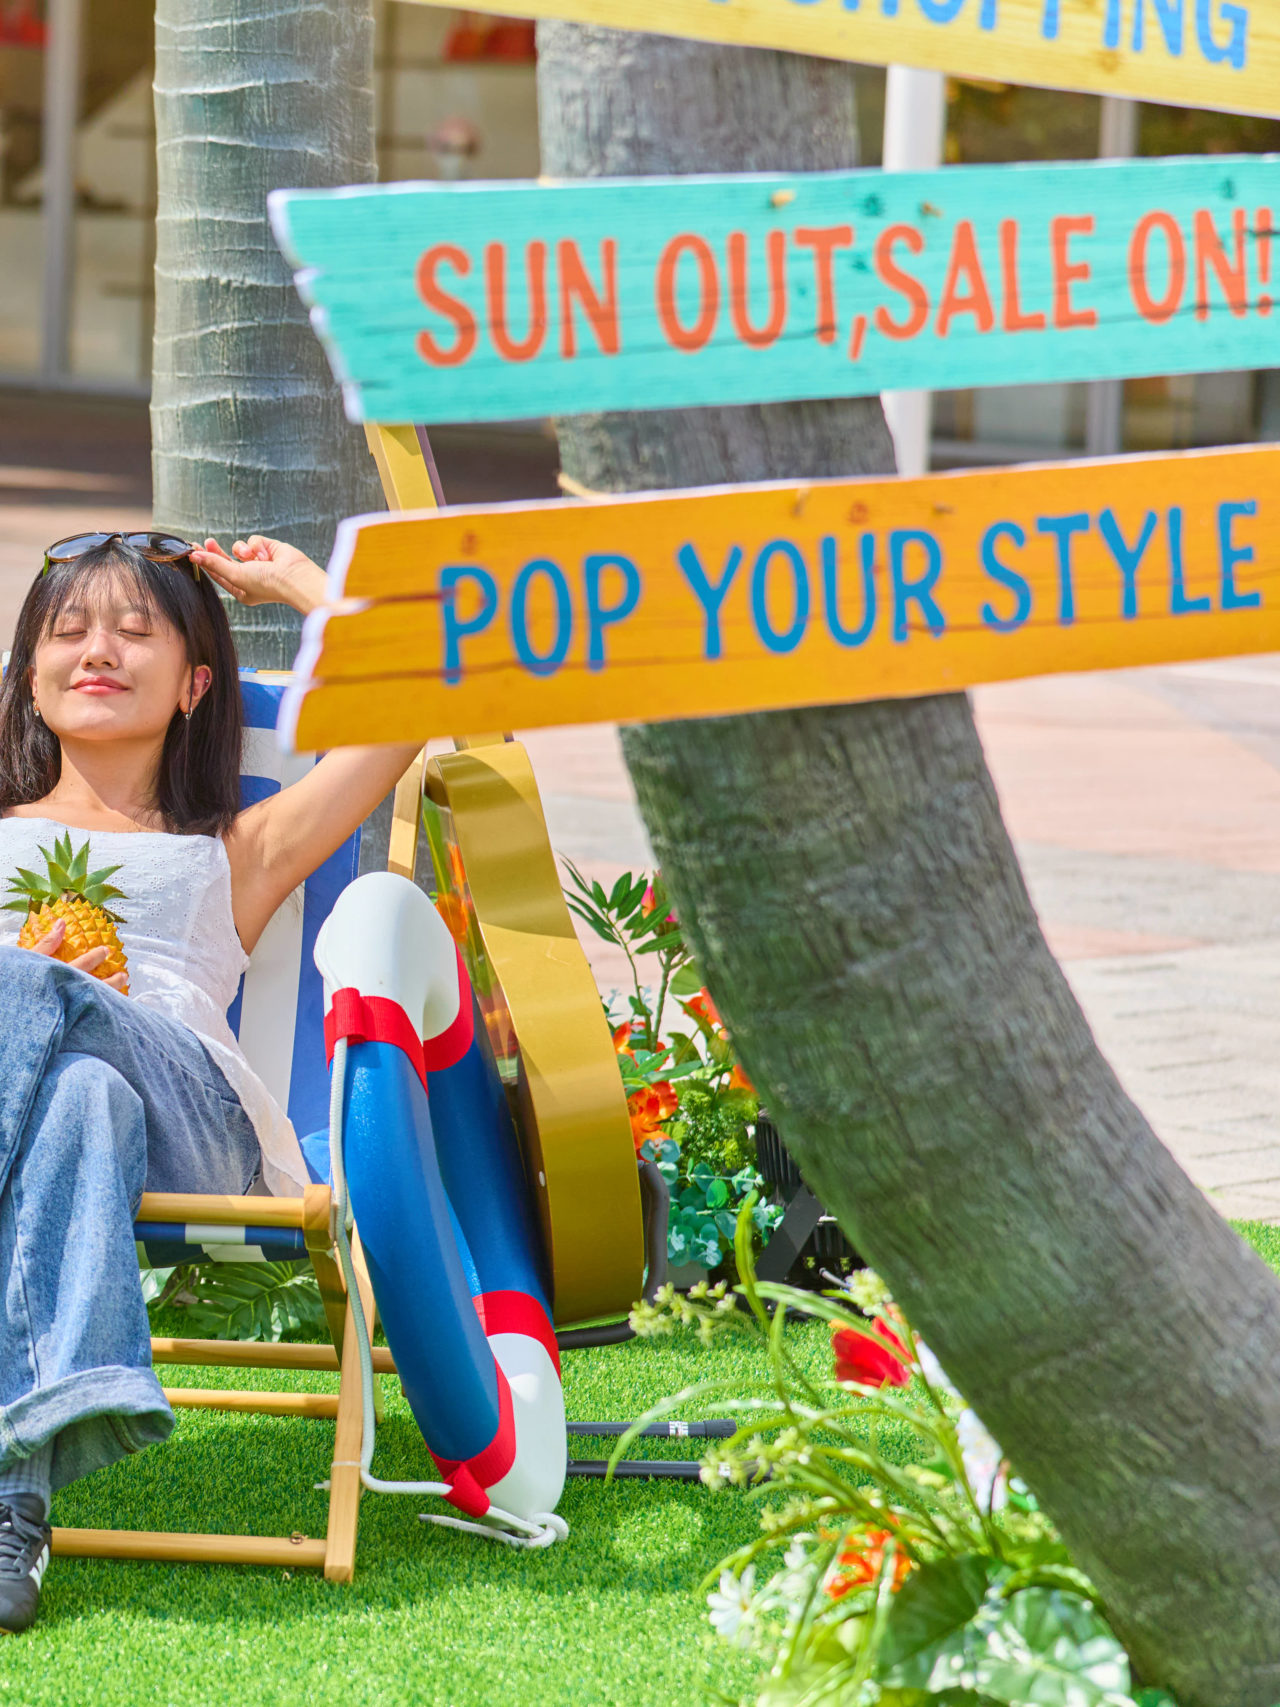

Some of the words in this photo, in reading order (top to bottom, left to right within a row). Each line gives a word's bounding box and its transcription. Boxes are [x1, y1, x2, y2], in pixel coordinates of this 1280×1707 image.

[414, 237, 621, 367] SUN
[1128, 206, 1273, 325] ON!
[437, 553, 642, 687] POP
[675, 528, 947, 661] YOUR
[979, 499, 1261, 635] STYLE
